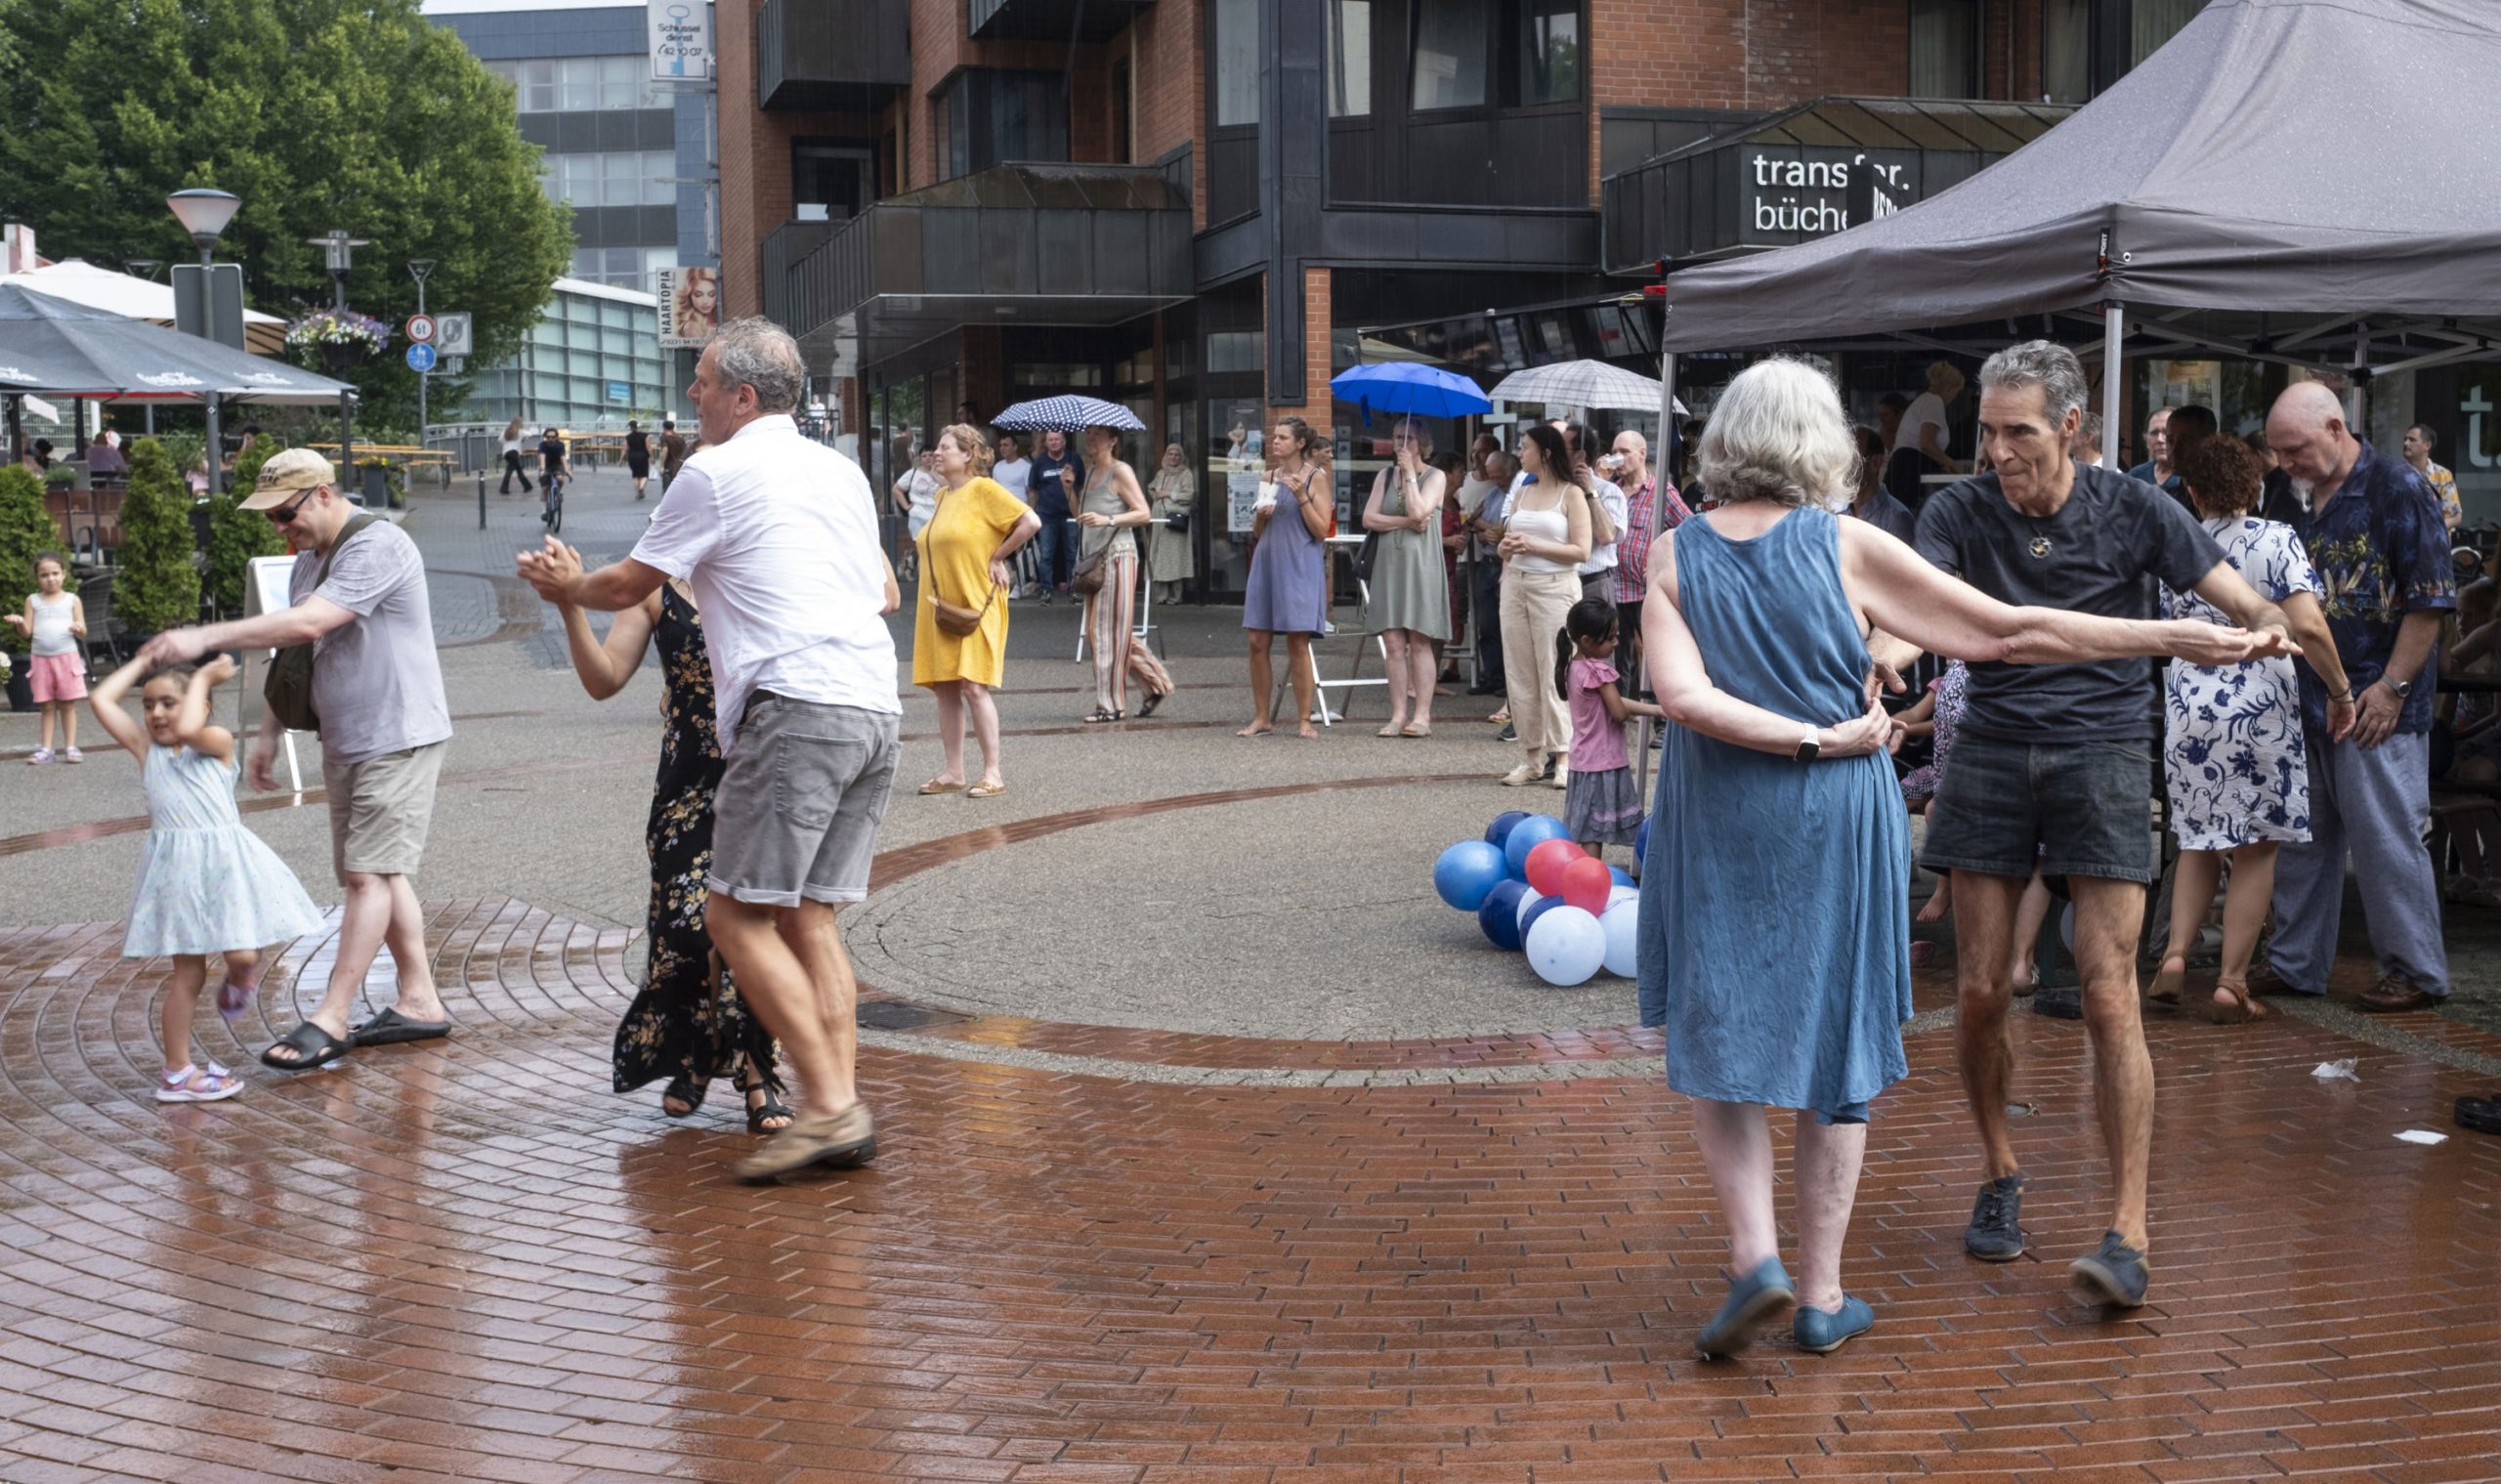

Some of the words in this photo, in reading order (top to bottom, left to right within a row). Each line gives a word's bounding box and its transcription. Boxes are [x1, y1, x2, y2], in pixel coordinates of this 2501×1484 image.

[690, 47, 702, 57] 07
[1755, 196, 1847, 232] büch
[660, 270, 672, 334] HAARTOPIA
